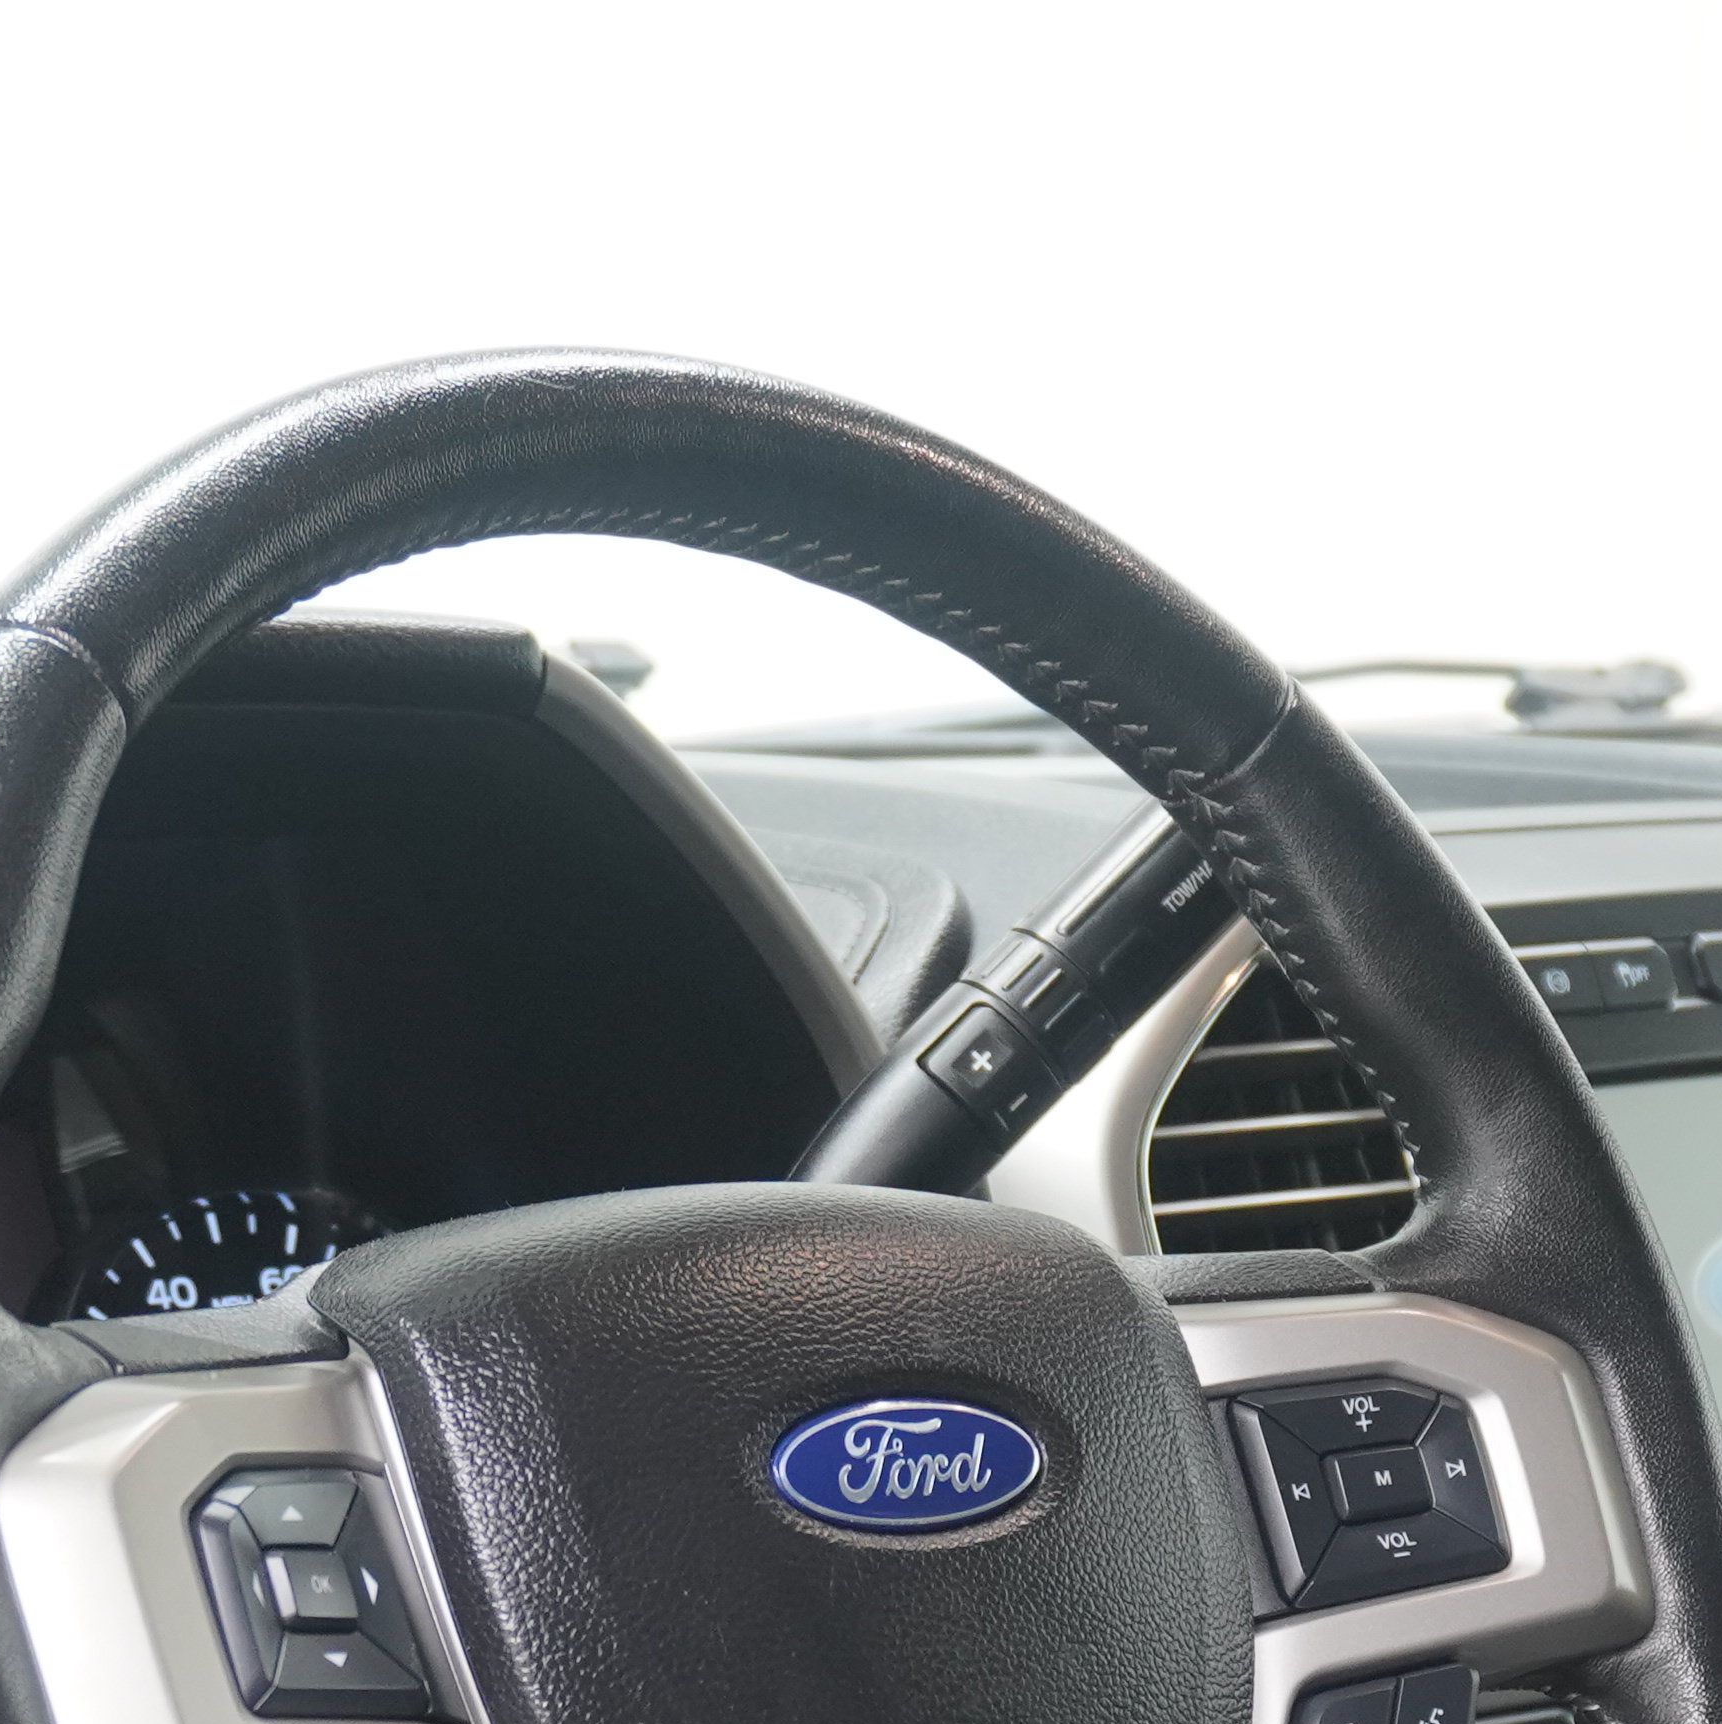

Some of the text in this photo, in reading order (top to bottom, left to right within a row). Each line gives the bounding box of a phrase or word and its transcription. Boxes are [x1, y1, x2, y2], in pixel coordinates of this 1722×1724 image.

[146, 1275, 198, 1310] 40
[1342, 1396, 1380, 1415] VOL
[838, 1417, 991, 1504] Ford
[1374, 1470, 1393, 1487] M
[1377, 1531, 1417, 1550] VOL
[311, 1575, 333, 1594] OK
